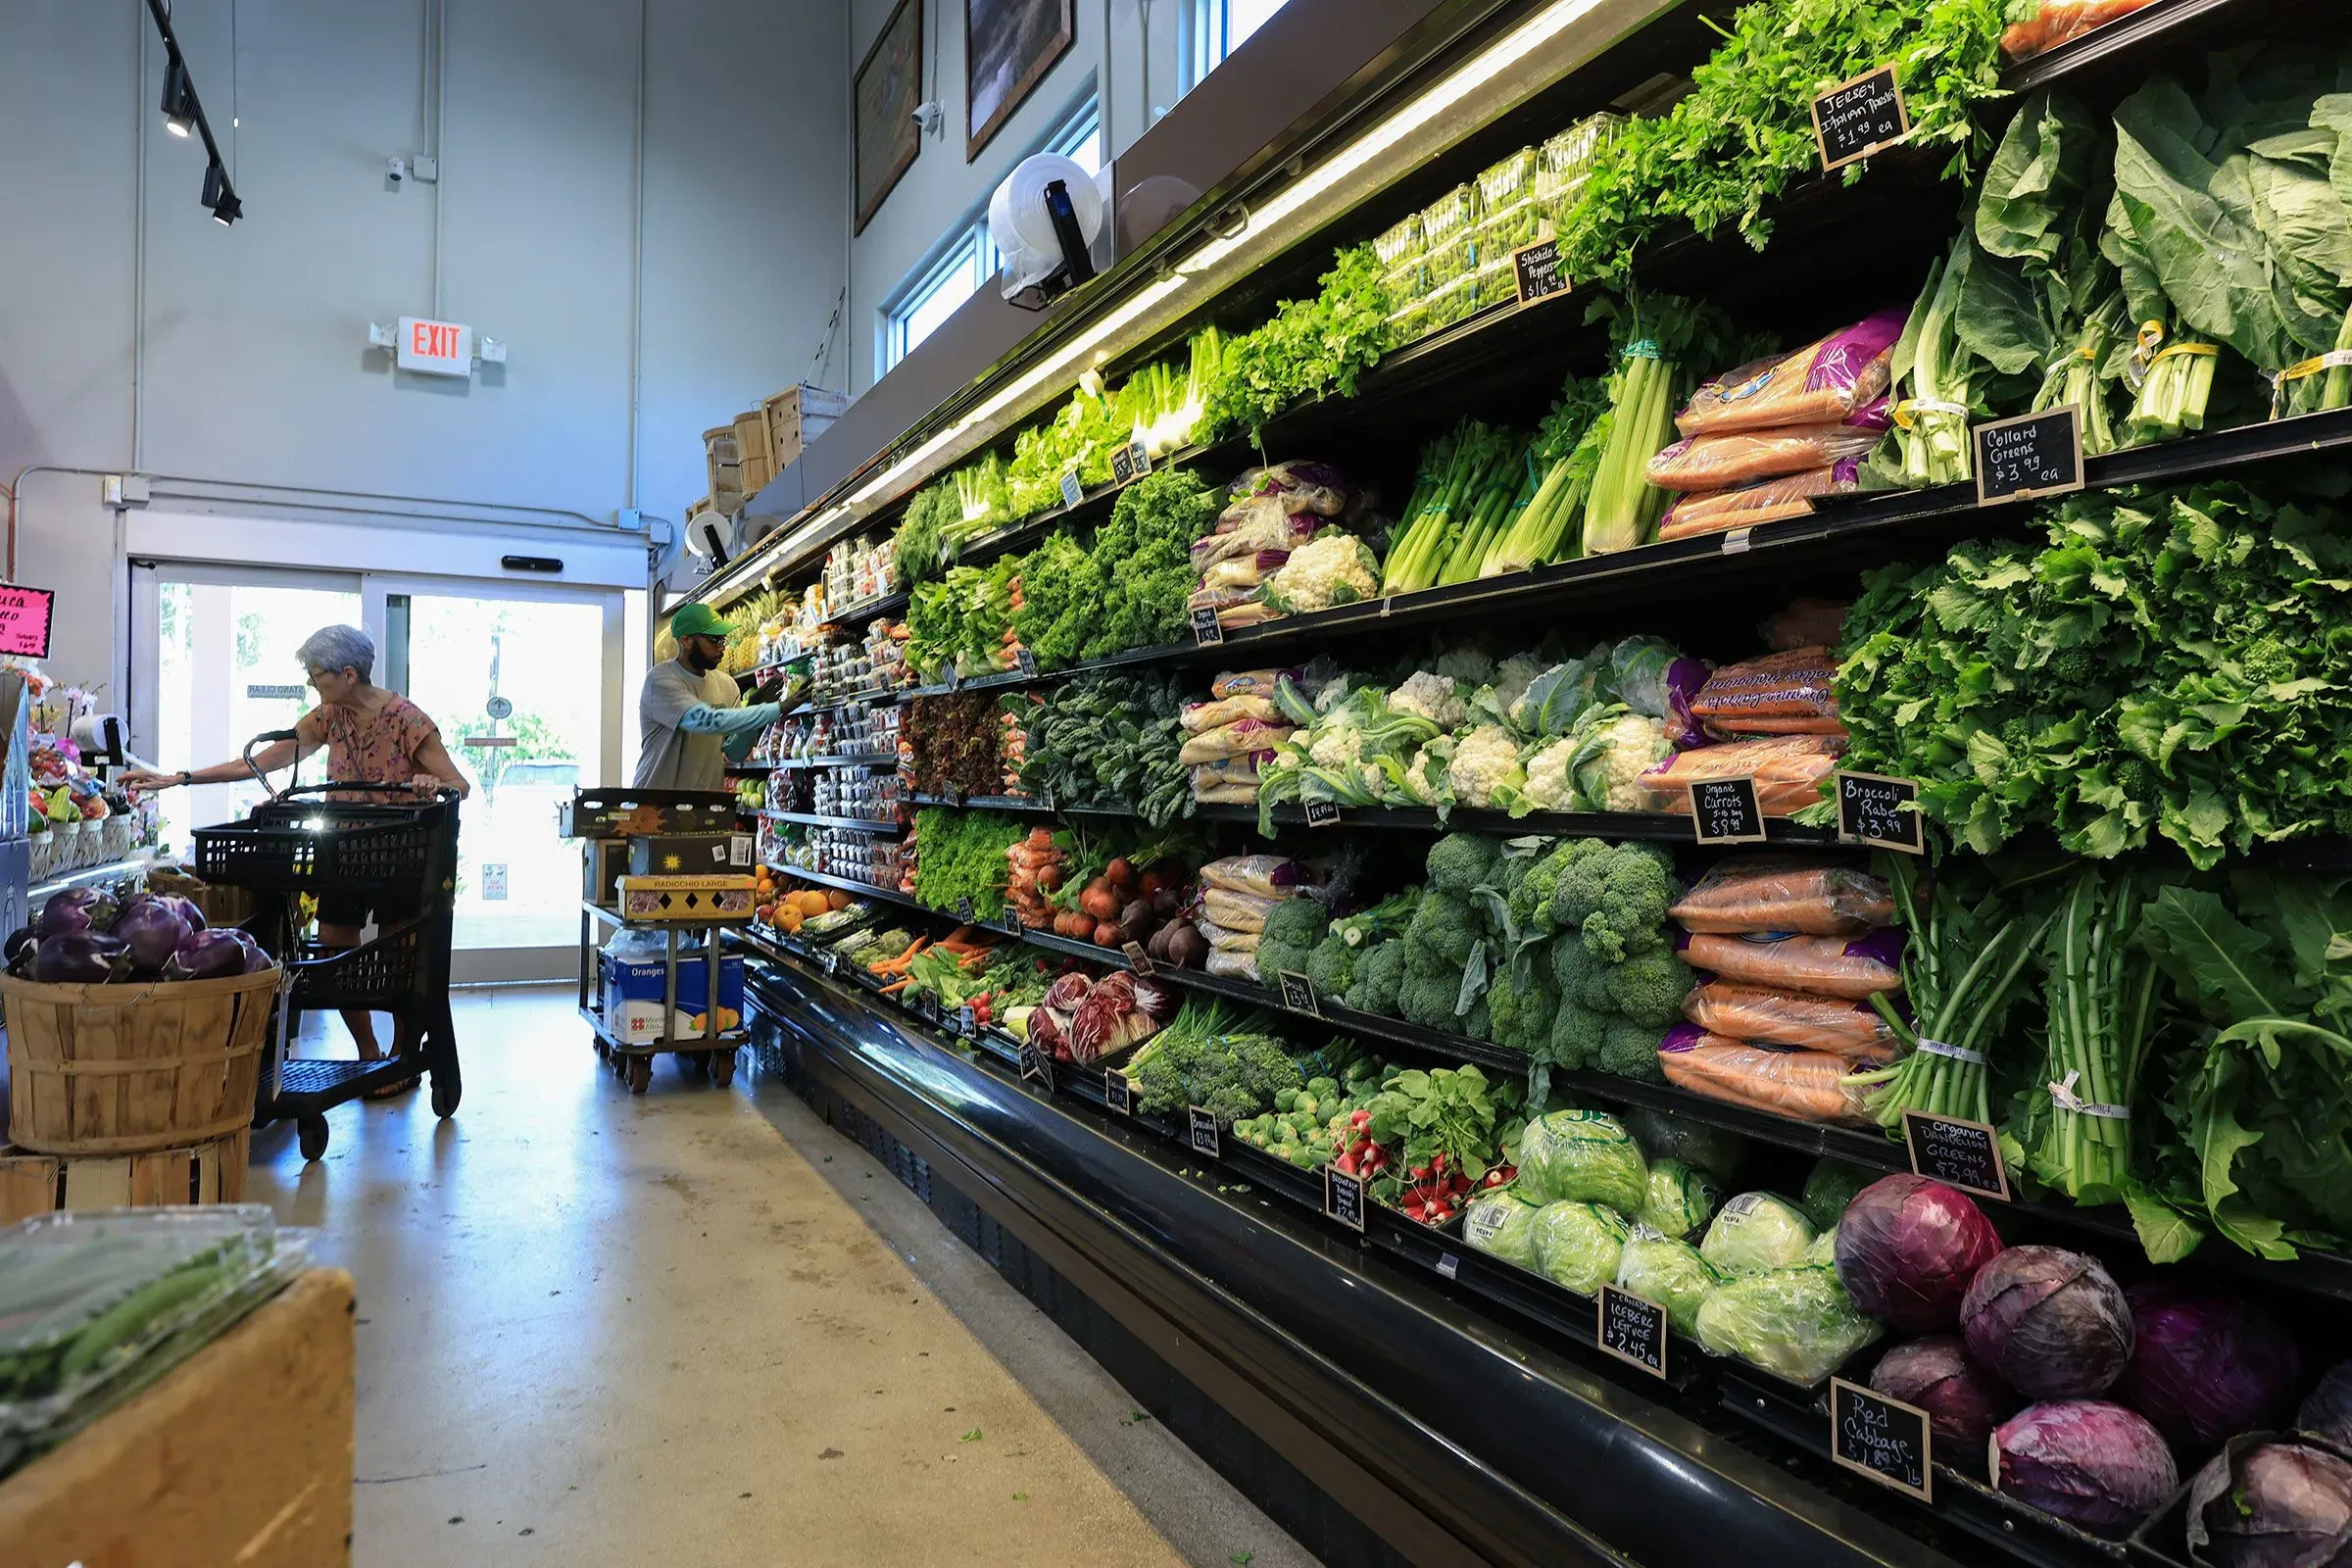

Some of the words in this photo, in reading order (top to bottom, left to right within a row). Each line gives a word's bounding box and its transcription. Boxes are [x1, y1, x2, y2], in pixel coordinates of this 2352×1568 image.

[1825, 81, 1875, 115] JERSEY
[1879, 121, 1893, 133] ea
[414, 323, 460, 361] EXIT
[1987, 424, 2036, 447] Collard
[1990, 442, 2034, 465] Greens
[2041, 468, 2059, 481] ea
[1705, 692, 1761, 710] Carrots
[1764, 687, 1830, 707] Organic
[1705, 795, 1742, 809] Carrots
[1706, 783, 1736, 798] Organic
[1845, 779, 1899, 802] Broccoli
[1861, 799, 1896, 818] Rabe
[1857, 816, 1901, 839] $3.99
[631, 967, 665, 977] Oranges
[1921, 1126, 1987, 1151] DANDELION
[1927, 1144, 1986, 1169] GREENS
[1936, 1160, 1982, 1187] $3.99
[1983, 1179, 1999, 1191] ea
[1610, 1302, 1653, 1328] ICEBERG
[1612, 1317, 1650, 1341] LETTUCE
[1852, 1393, 1887, 1427] Red
[1844, 1416, 1914, 1464] Cabbage
[1905, 1464, 1922, 1486] lb
